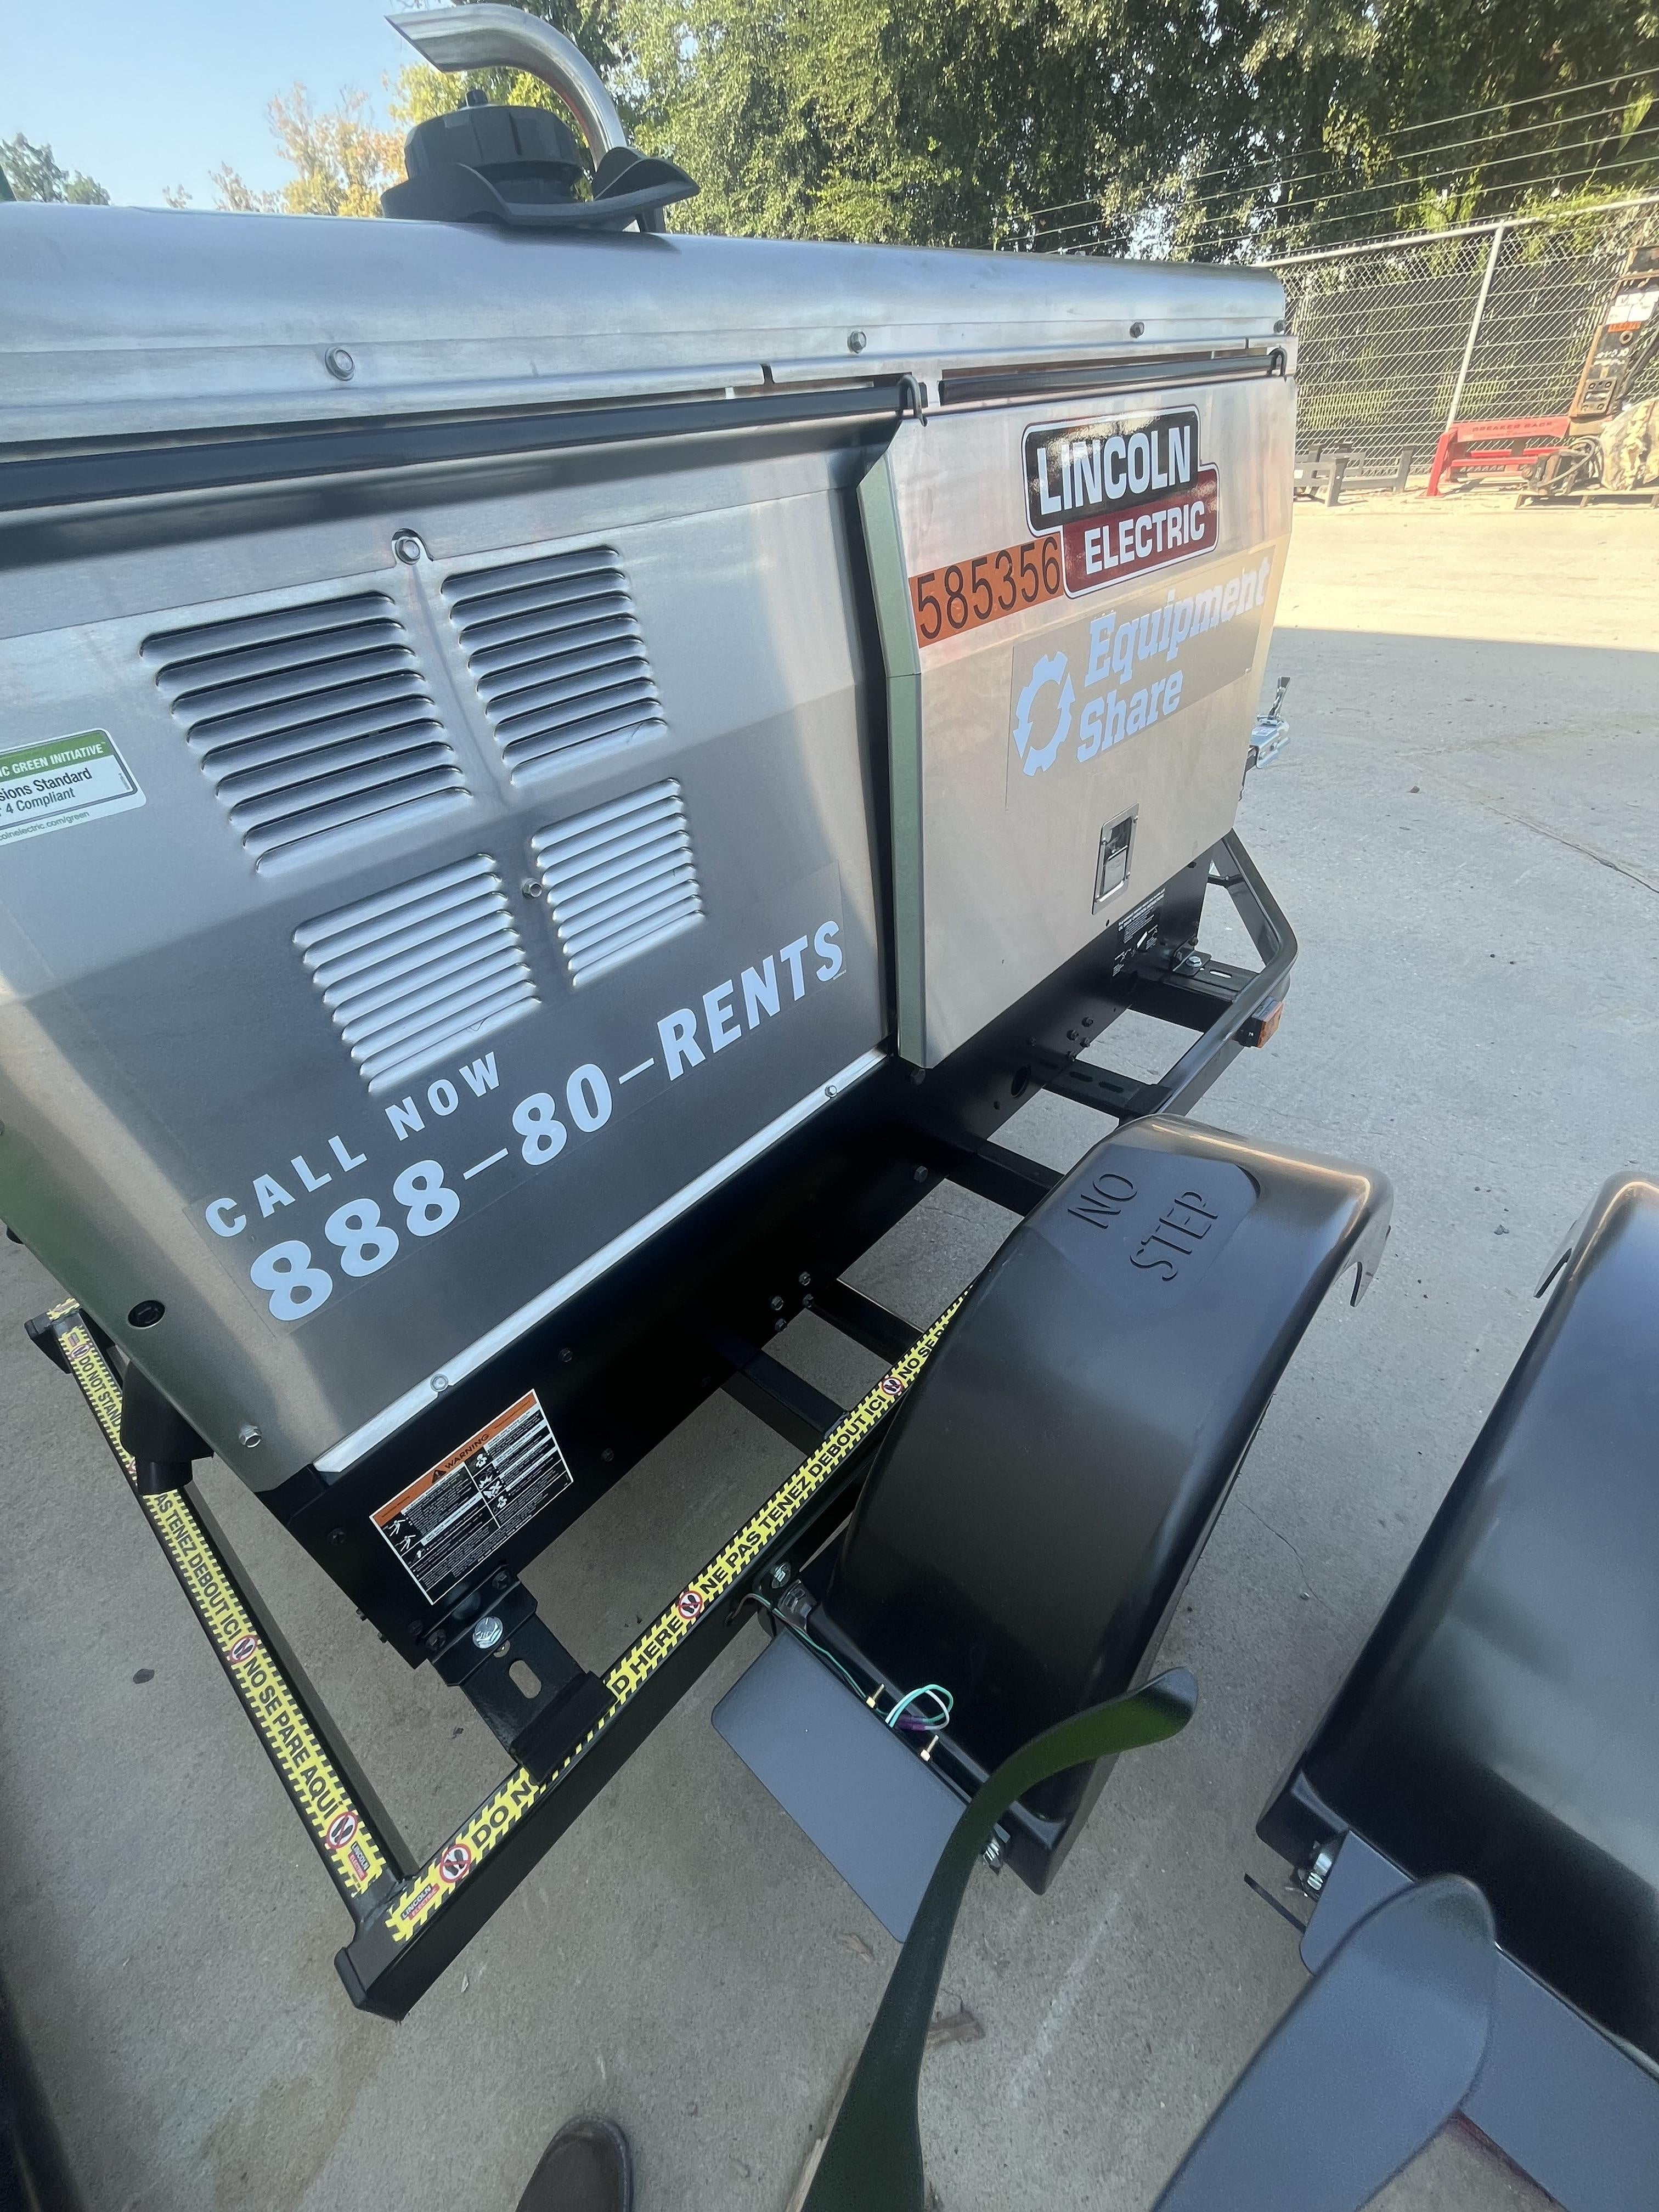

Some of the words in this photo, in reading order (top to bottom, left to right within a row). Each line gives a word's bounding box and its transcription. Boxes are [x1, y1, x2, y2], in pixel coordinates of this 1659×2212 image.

[1036, 426, 1191, 515] LINCOLN
[1084, 501, 1205, 575] ELECTRIC
[918, 537, 1060, 640] 585356
[1084, 556, 1269, 687] Equipment
[1076, 670, 1183, 763] Share
[0, 785, 32, 801] sions
[33, 768, 92, 791] Standard
[12, 757, 48, 774] GREEN
[50, 743, 103, 765] INITIATIVE
[6, 803, 13, 814] 4
[16, 787, 76, 811] Compliant
[205, 1135, 367, 1237] CALL
[385, 1052, 499, 1141] NOW
[1068, 1173, 1138, 1229] NO
[1130, 1191, 1218, 1281] STEP
[79, 1356, 95, 1372] DO
[86, 1370, 106, 1392] NOT
[898, 1358, 920, 1379] NO
[917, 1339, 934, 1358] SE
[98, 1391, 121, 1427] STAND
[445, 1434, 490, 1469] WARNING
[699, 1566, 728, 1594] NE
[725, 1531, 761, 1568] PAS
[758, 1476, 811, 1530] TENEZ
[808, 1414, 866, 1477] DEBOUT
[864, 1395, 887, 1416] ICI
[154, 1494, 173, 1513] AS
[166, 1509, 198, 1557] TENEZ
[188, 1553, 230, 1615] DEBOUT
[220, 1613, 242, 1640] ICI
[629, 1616, 684, 1675] HERE
[244, 1657, 267, 1688] NO
[259, 1685, 282, 1716] SE
[273, 1711, 310, 1768] PARE
[471, 1805, 509, 1849] DO
[352, 1842, 369, 1870] LINCOLN
[402, 1886, 431, 1918] LINCOLN
